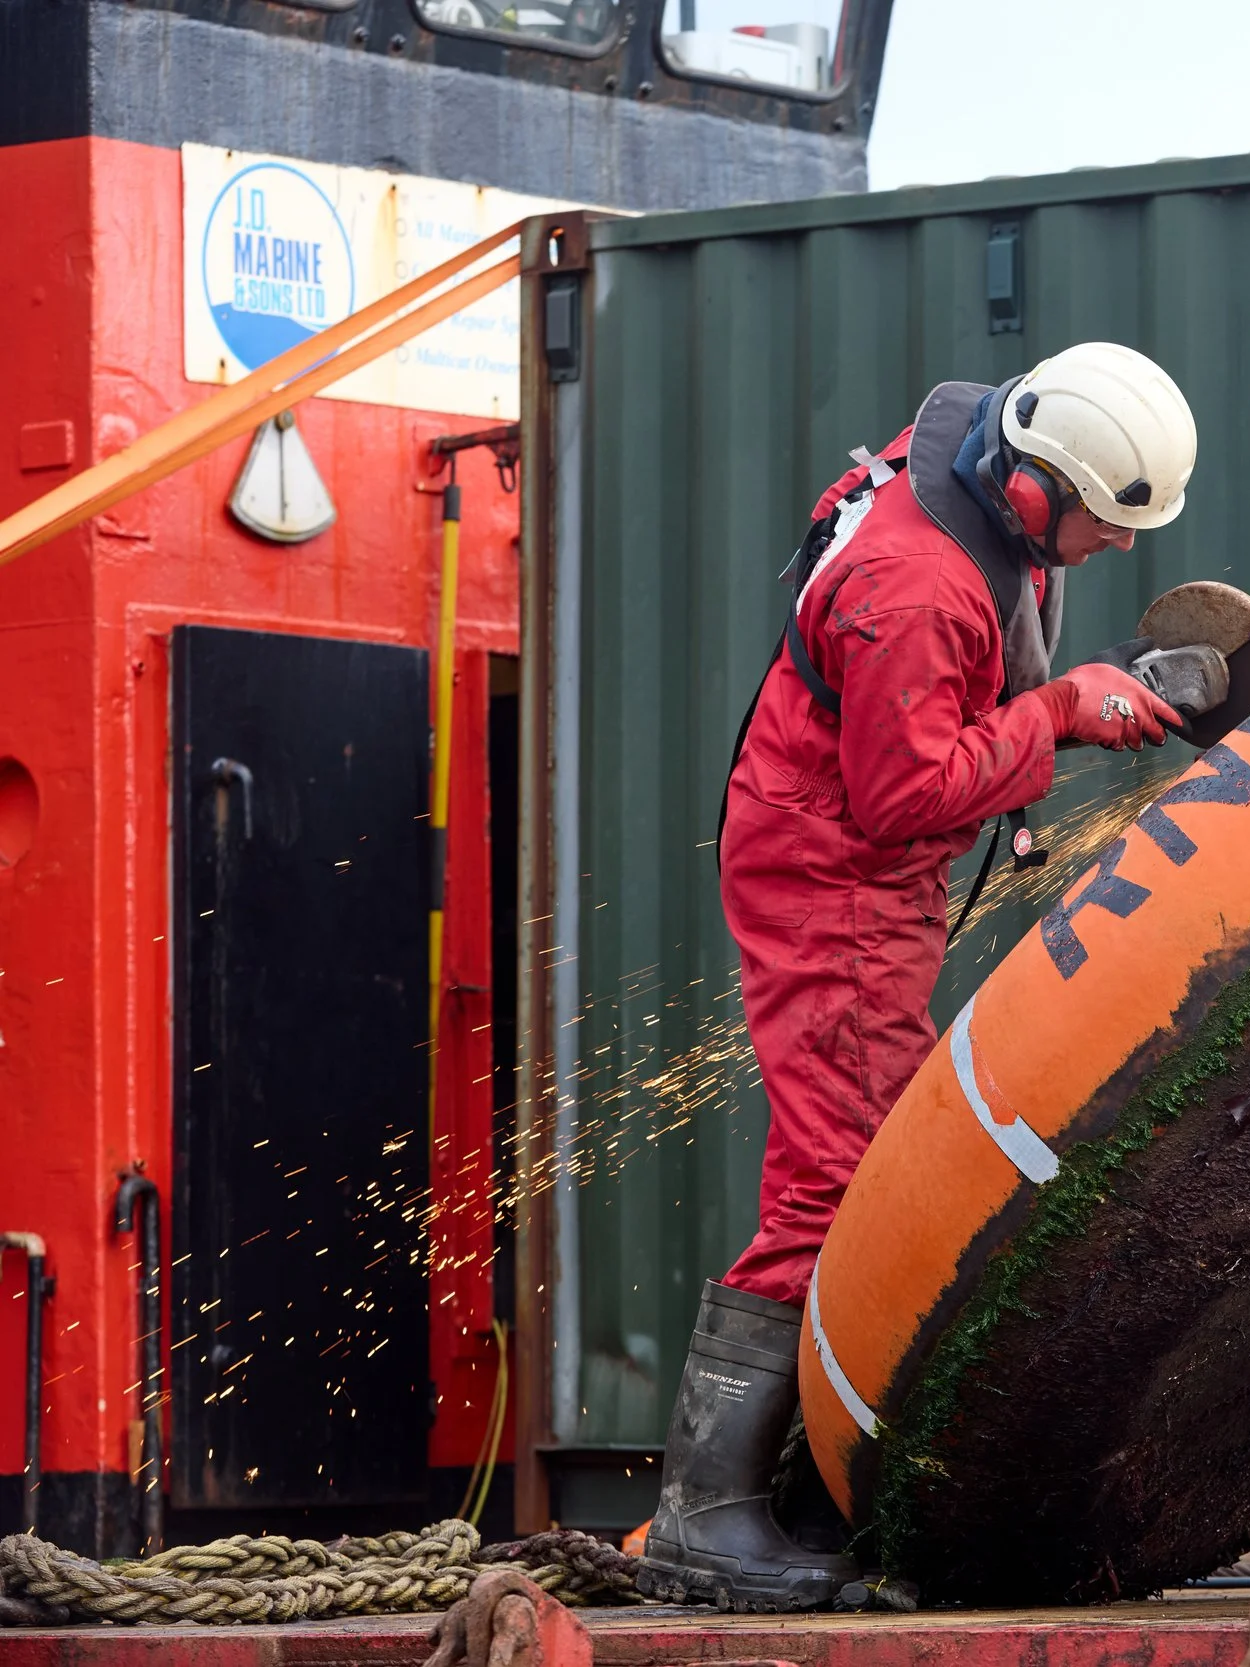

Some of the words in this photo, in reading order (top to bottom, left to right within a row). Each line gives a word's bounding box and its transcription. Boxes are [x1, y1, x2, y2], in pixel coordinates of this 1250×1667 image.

[233, 186, 272, 232] J.D.
[234, 231, 323, 285] MARINE
[296, 286, 325, 319] LTD
[705, 1373, 751, 1387] DUNLOP
